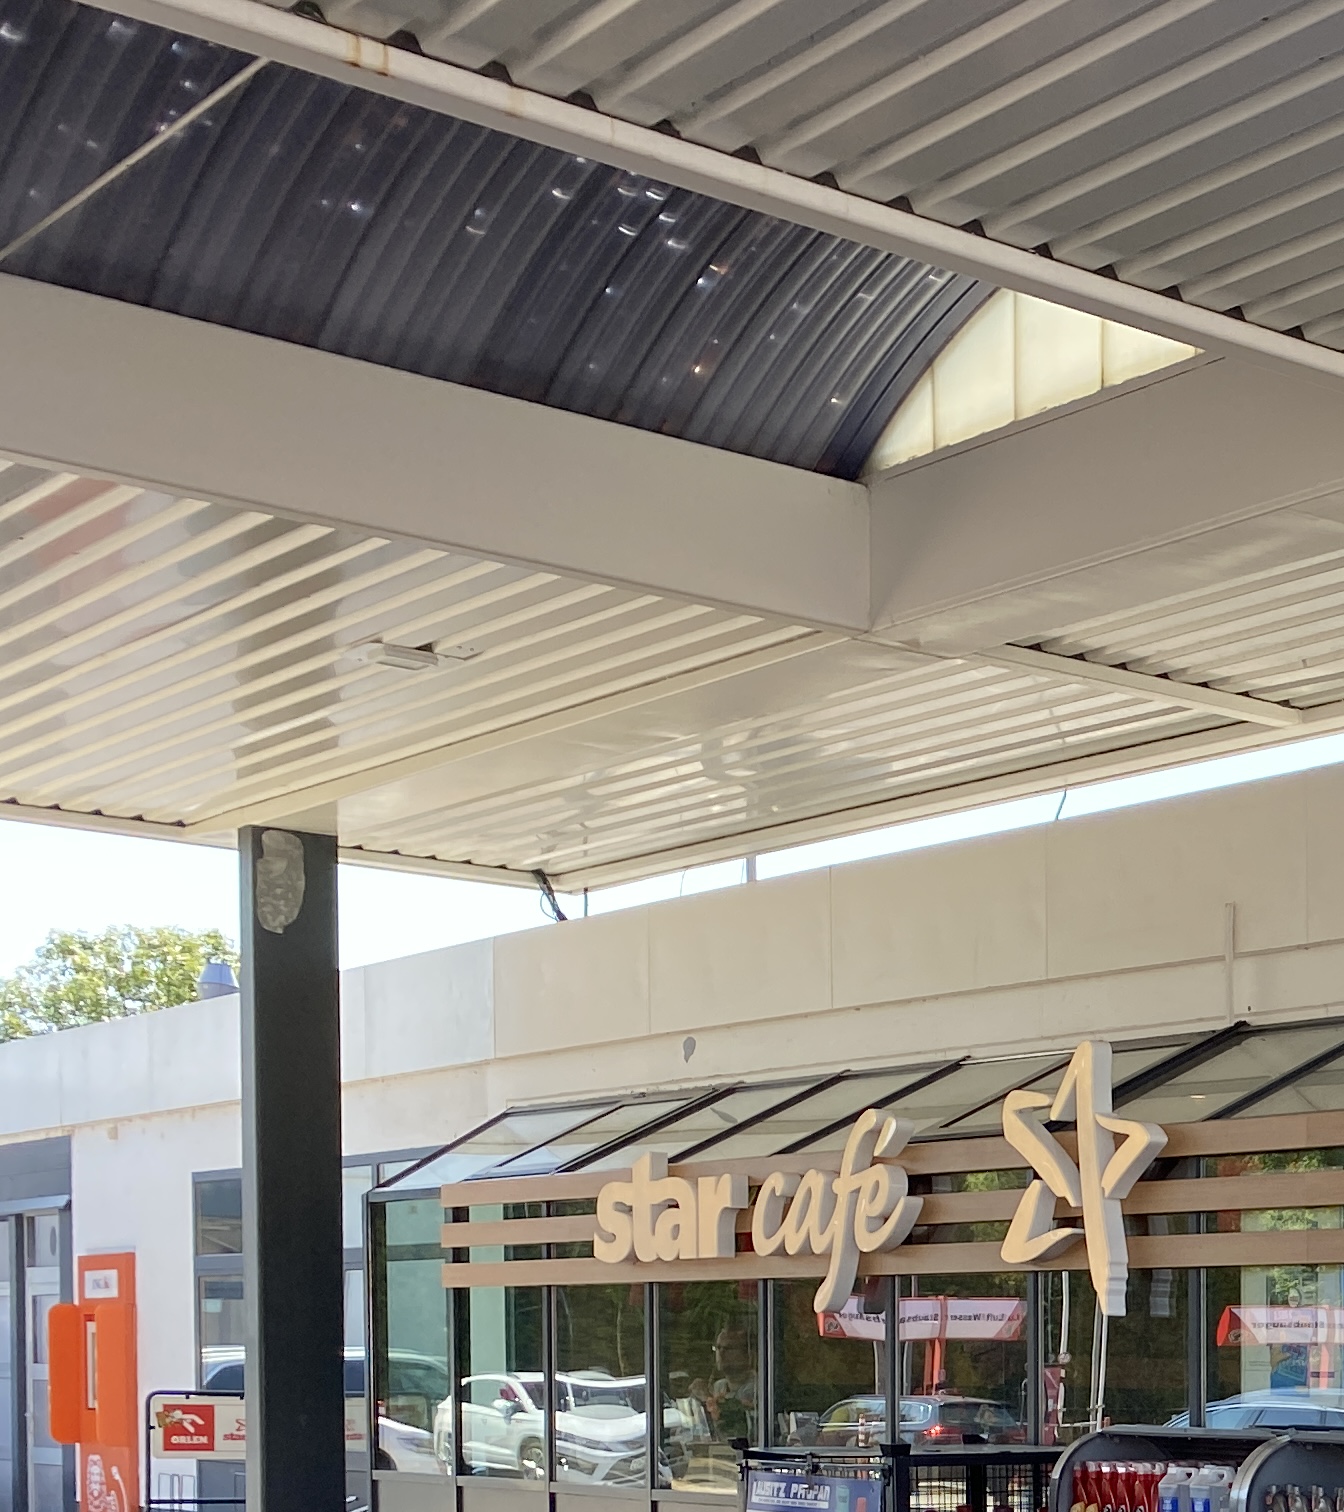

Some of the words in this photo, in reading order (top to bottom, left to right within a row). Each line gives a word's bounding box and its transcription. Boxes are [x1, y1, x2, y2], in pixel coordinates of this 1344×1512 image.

[593, 1151, 749, 1264] star
[751, 1108, 924, 1314] café
[170, 1435, 208, 1444] ORLEN
